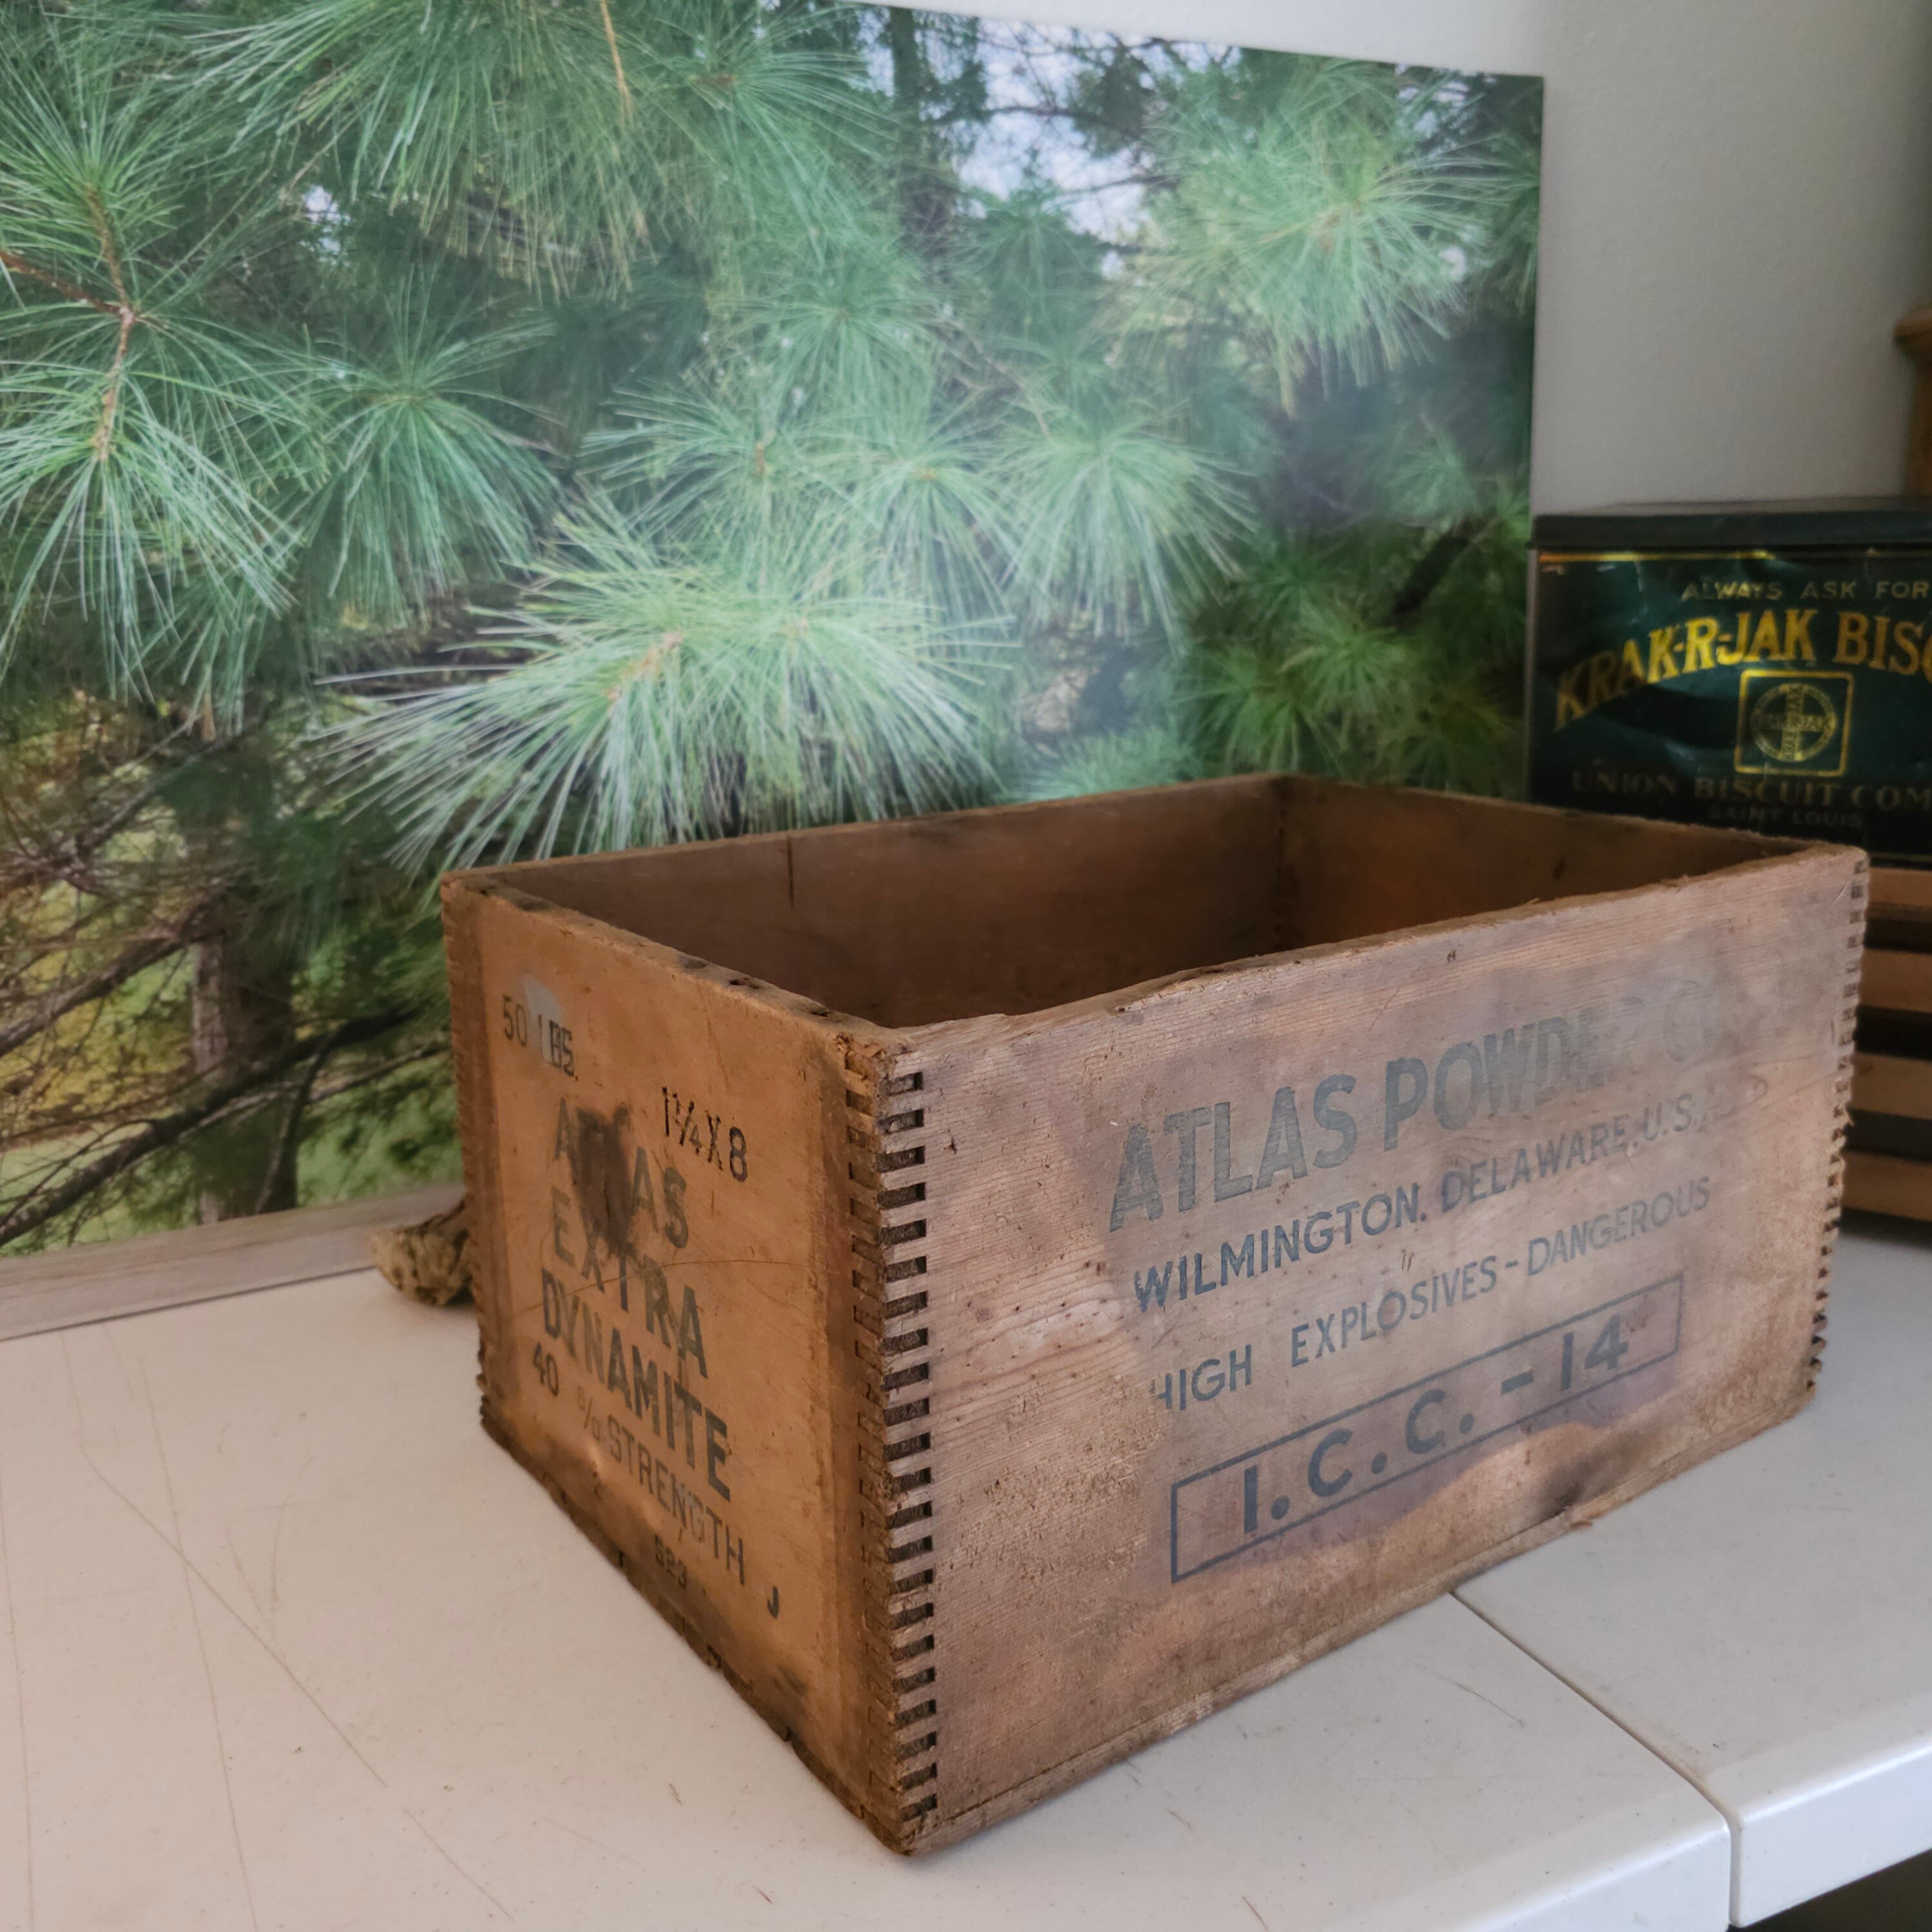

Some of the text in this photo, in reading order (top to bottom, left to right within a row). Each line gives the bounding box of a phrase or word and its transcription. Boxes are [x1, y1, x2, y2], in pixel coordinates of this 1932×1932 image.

[1681, 581, 1930, 601] ALWAYS ASK FOR
[1572, 769, 1678, 796] UNION
[1693, 777, 1840, 808] BISCUIT
[1709, 805, 1864, 828] SAINT LOUIS
[502, 994, 528, 1047] 50
[1109, 1074, 1358, 1233] ATLAS
[542, 1268, 731, 1503] DYNAMITE
[533, 1342, 560, 1396] 40
[608, 1414, 745, 1585] STRENGTH
